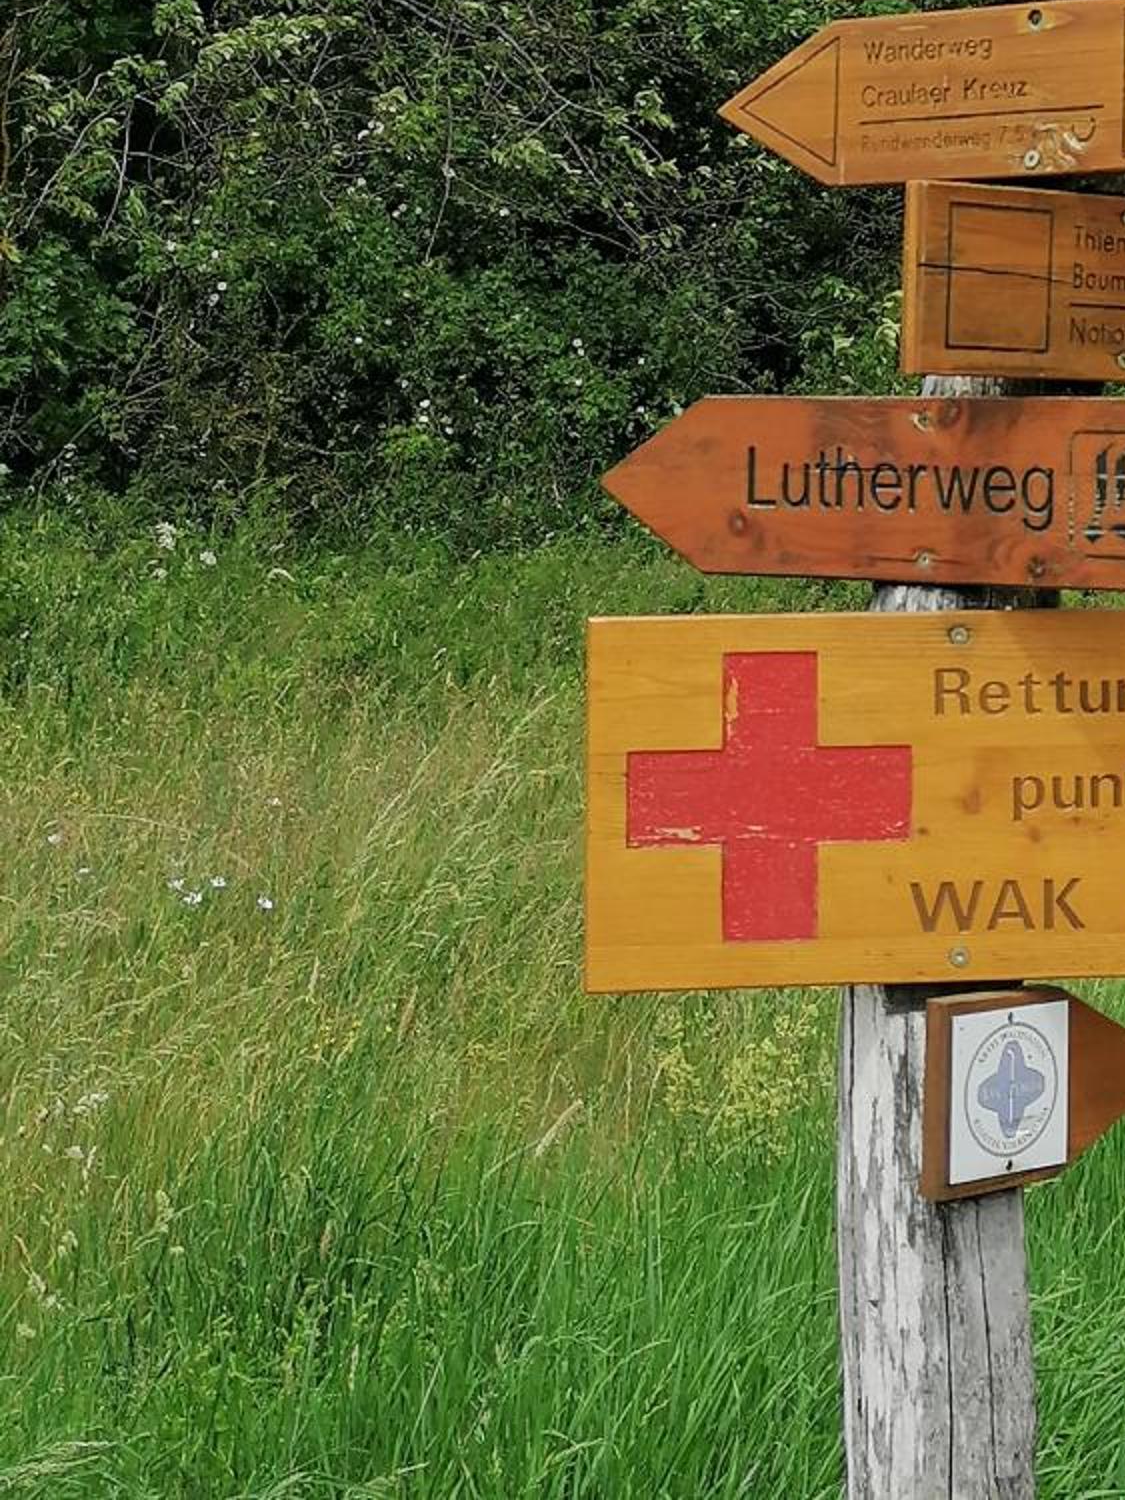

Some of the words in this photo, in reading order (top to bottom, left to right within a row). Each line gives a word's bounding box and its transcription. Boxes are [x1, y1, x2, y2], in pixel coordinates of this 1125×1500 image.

[863, 37, 993, 65] Wanderweg
[963, 77, 1027, 101] Kreuz
[747, 446, 1055, 532] Lutherweg
[910, 877, 1086, 933] WAK
